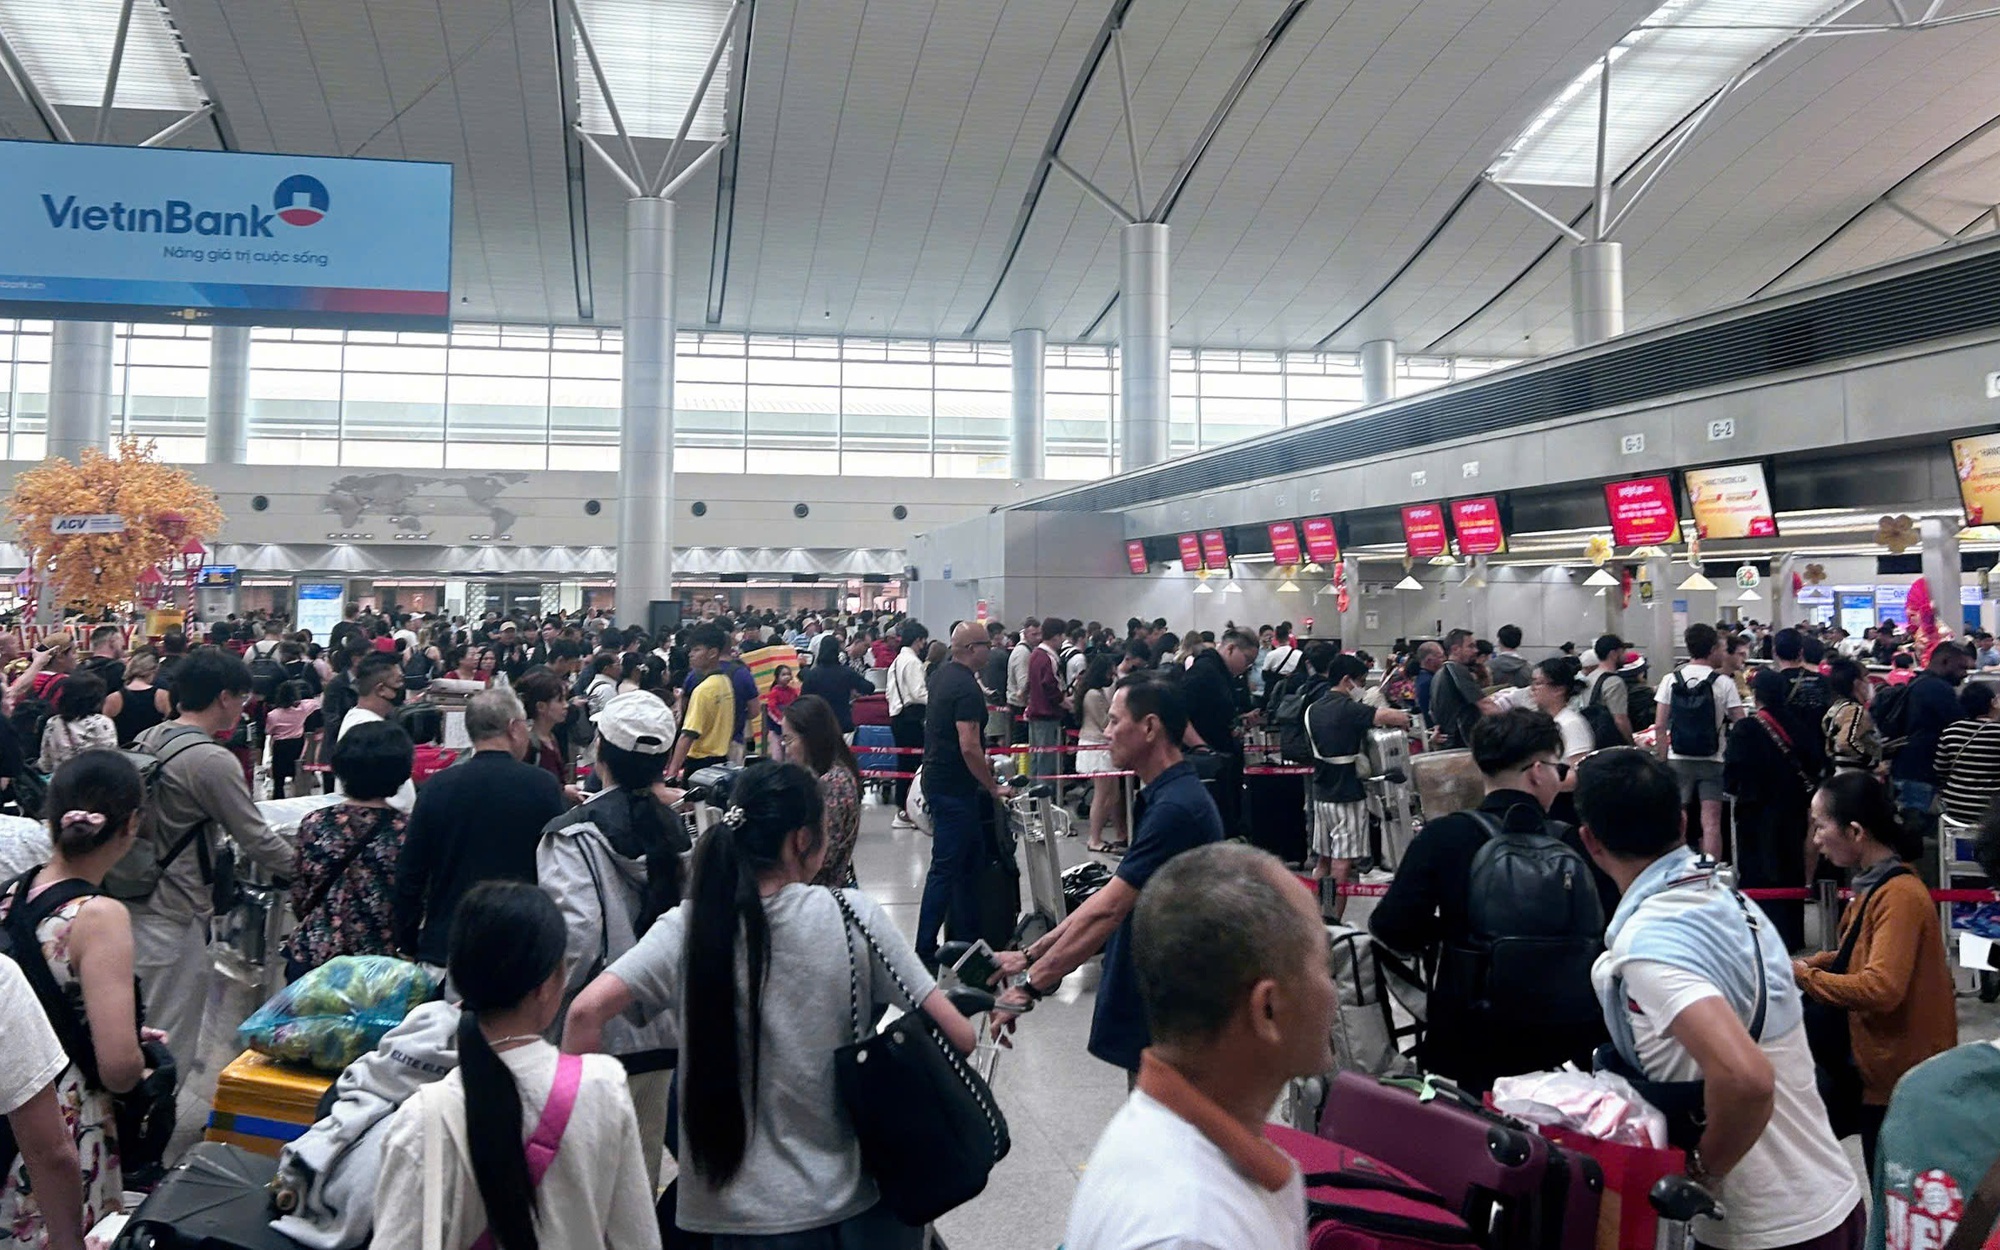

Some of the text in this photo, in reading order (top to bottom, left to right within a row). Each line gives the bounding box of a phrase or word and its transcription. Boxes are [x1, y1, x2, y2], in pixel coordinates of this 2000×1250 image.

[40, 193, 275, 238] VietinBank
[163, 246, 328, 267] Nâng giá trị cuộc sống
[1712, 421, 1733, 438] G-2
[56, 518, 88, 530] ACV
